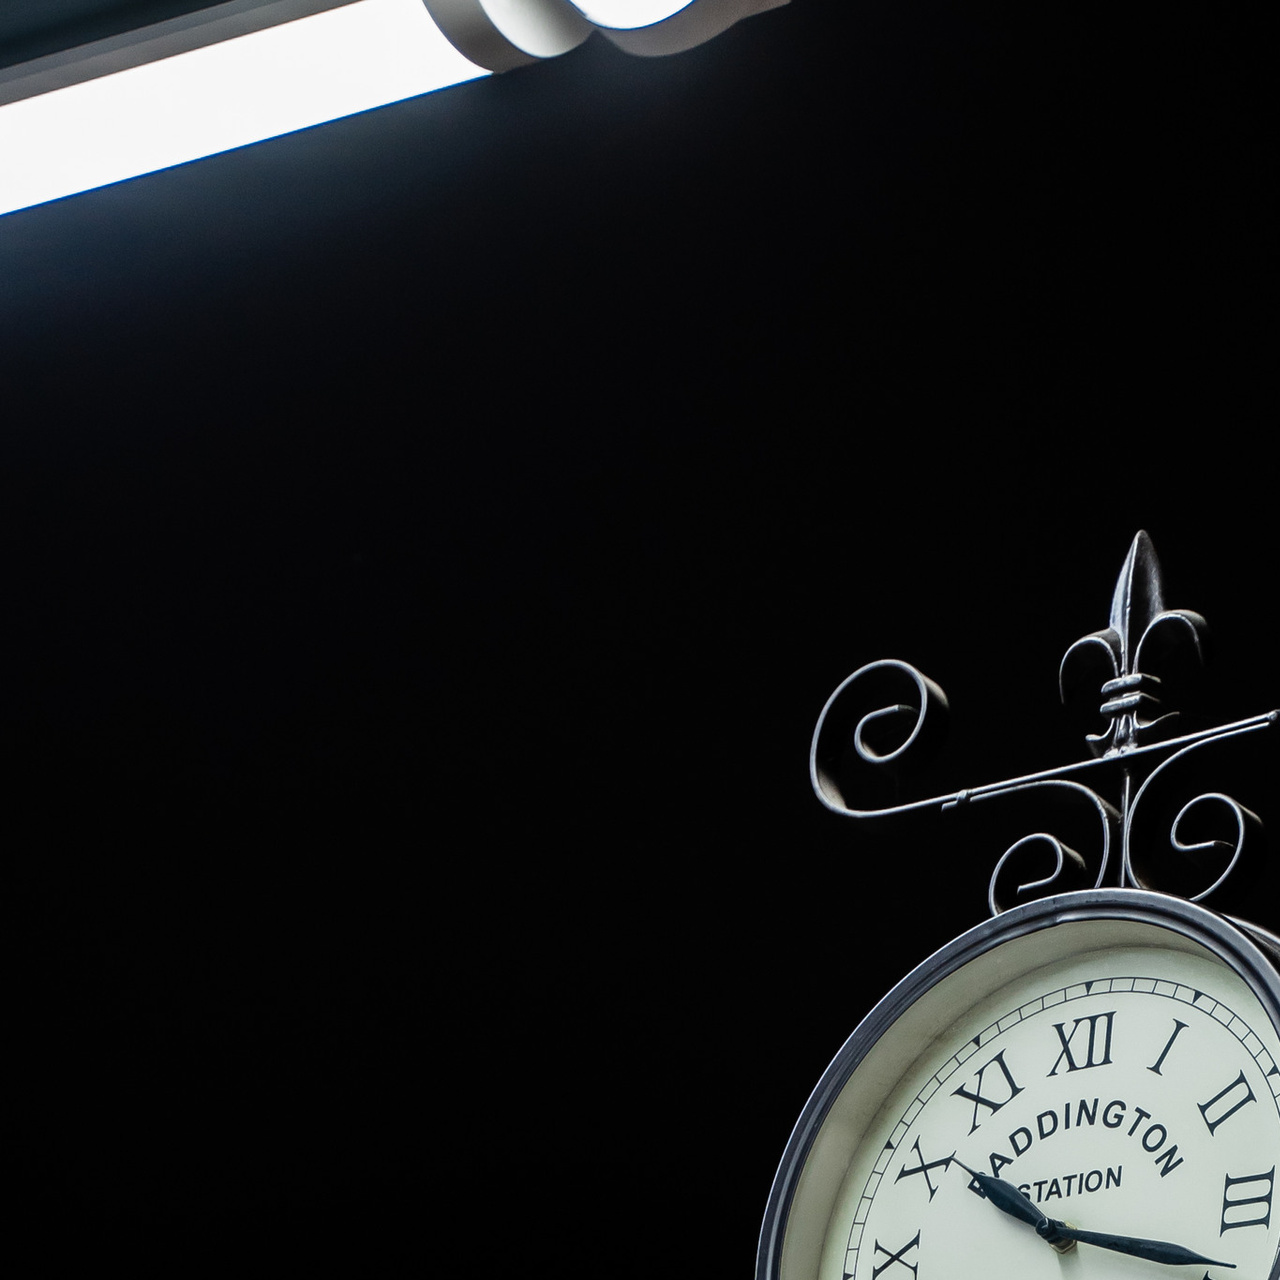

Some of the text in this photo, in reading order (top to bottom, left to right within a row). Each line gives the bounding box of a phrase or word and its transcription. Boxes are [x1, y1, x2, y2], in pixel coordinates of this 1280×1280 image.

[1047, 1011, 1117, 1077] XII
[1147, 1019, 1189, 1076] I
[951, 1049, 1026, 1135] XI
[1197, 1070, 1257, 1136] II
[894, 1135, 957, 1203] X
[1017, 1165, 1123, 1204] STATION
[1220, 1165, 1276, 1237] III
